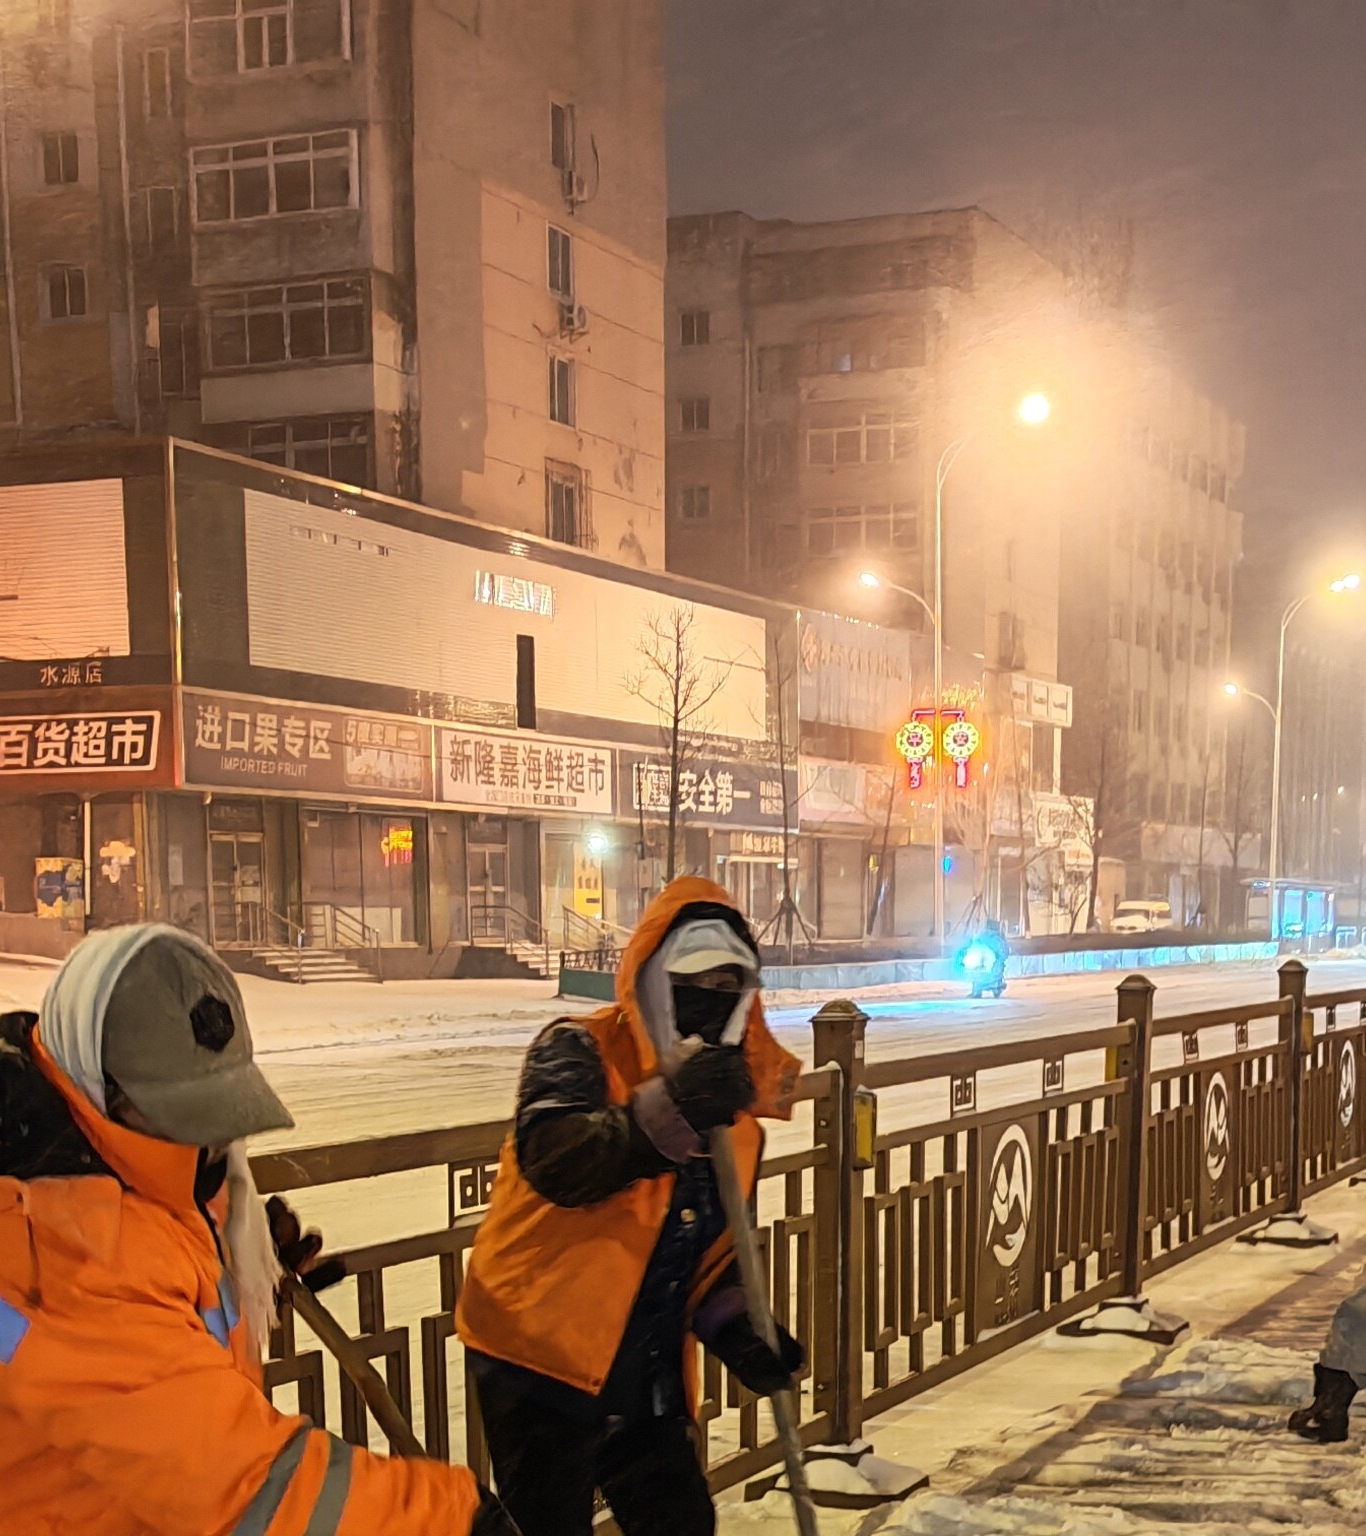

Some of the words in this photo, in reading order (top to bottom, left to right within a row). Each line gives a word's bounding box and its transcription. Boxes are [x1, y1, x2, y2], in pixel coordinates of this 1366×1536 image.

[39, 661, 102, 687] 水源店
[195, 705, 332, 760] 进口果专区
[221, 756, 276, 775] IMPORTED
[449, 734, 606, 796] 新隆嘉海鲜超市
[678, 768, 751, 816] 安全第一
